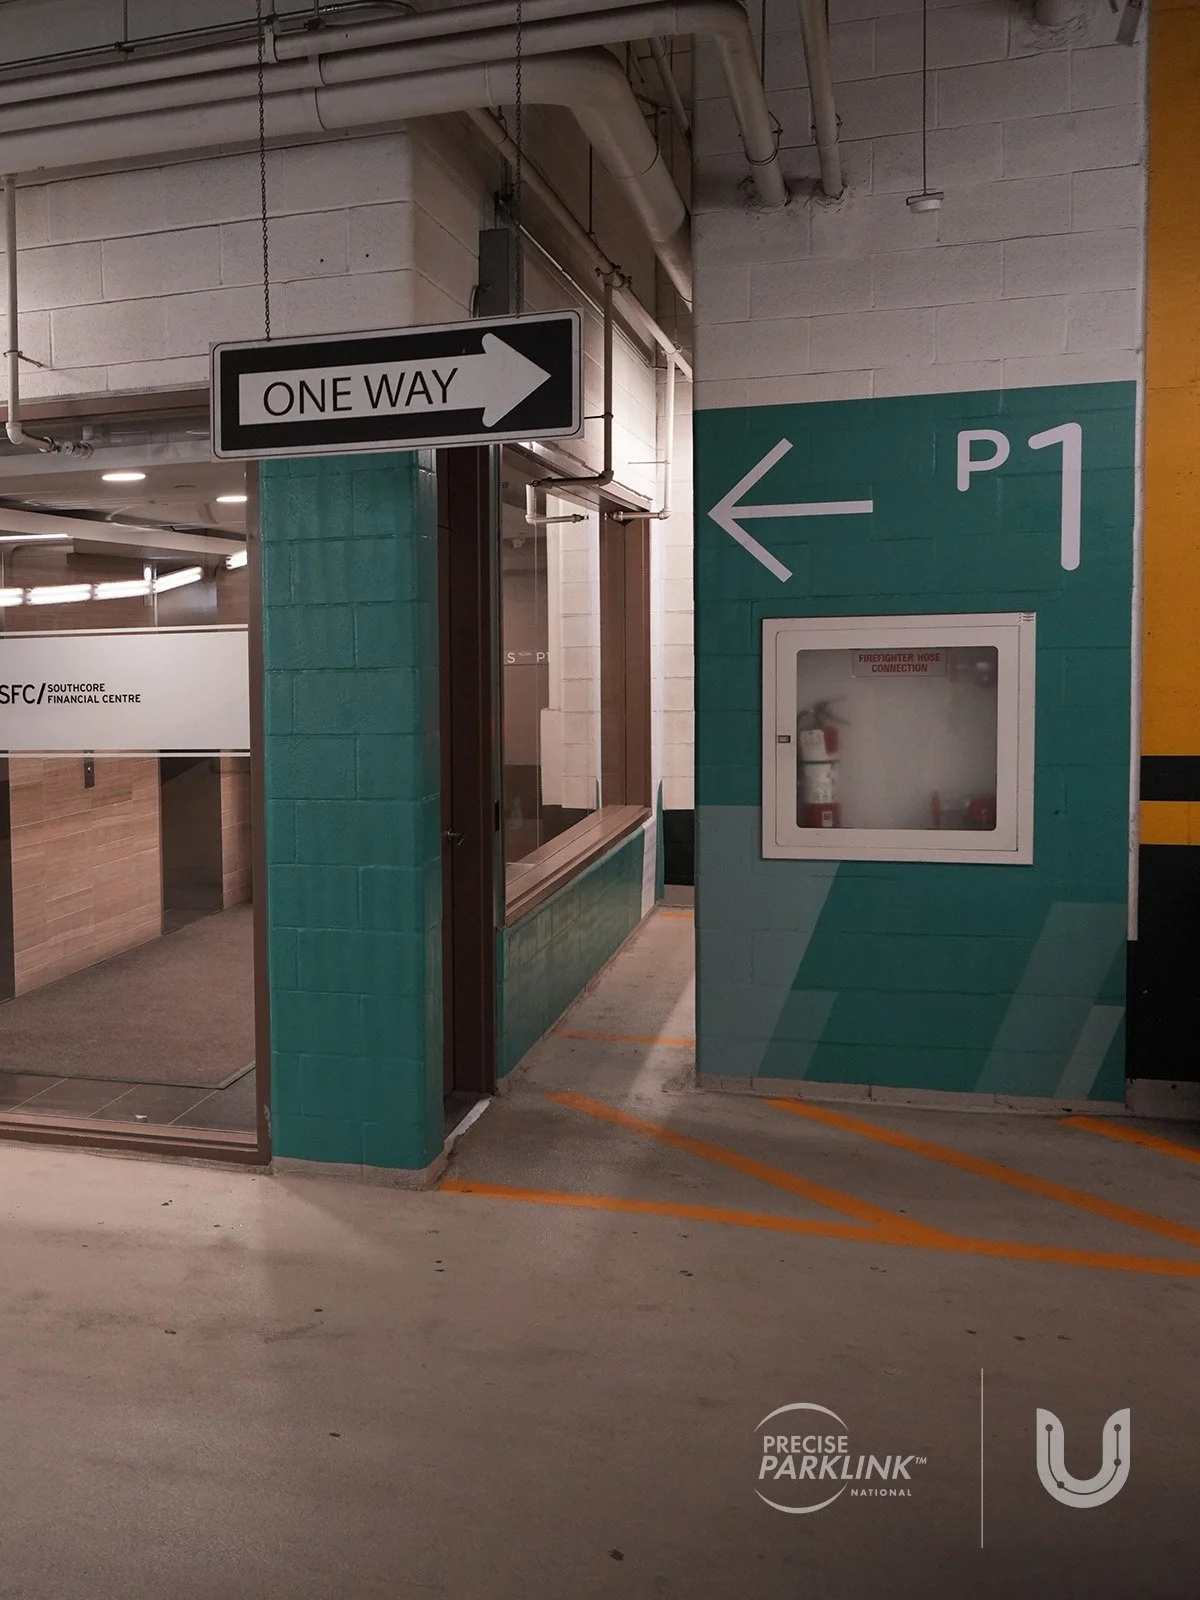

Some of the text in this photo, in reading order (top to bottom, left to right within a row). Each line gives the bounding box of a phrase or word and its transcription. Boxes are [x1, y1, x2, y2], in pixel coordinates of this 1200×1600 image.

[263, 367, 458, 416] ONE WAY
[858, 653, 941, 662] FIREFIGHTER HOSE
[871, 664, 928, 673] CONNECTION
[47, 683, 105, 693] SOUTHCORE
[47, 694, 141, 704] FINANCIAL CENTRE
